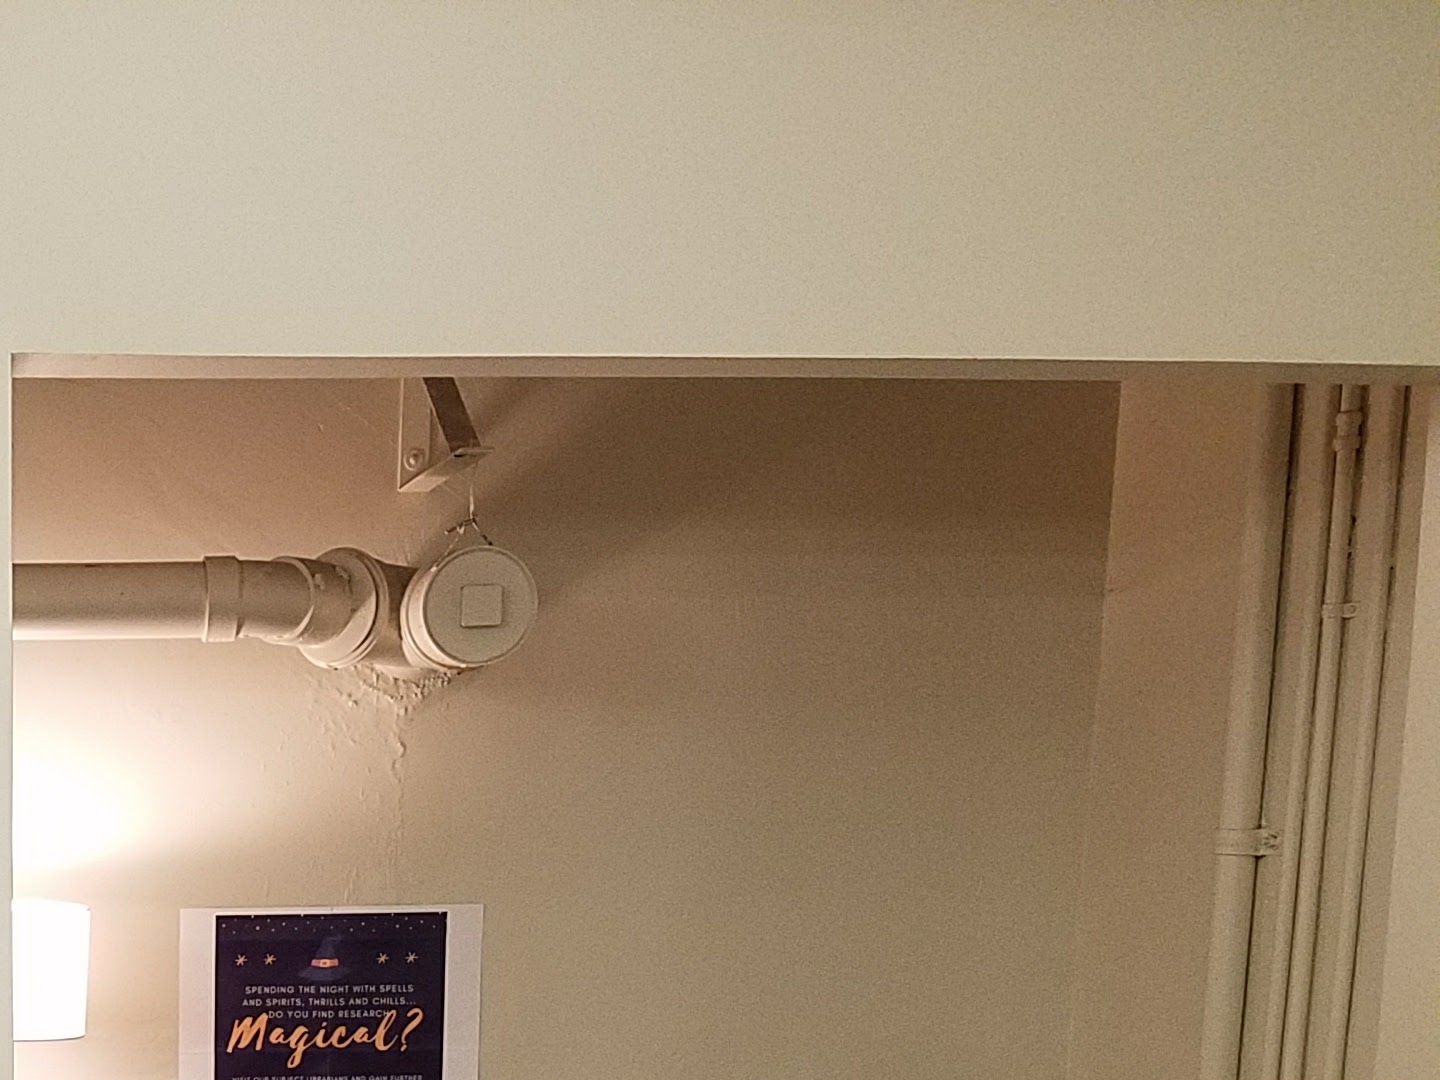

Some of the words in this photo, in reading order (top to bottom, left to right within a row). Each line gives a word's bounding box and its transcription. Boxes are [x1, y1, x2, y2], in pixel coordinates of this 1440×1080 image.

[245, 985, 295, 995] SPENDING
[299, 985, 316, 994] THE
[320, 985, 349, 994] NIGHT
[353, 985, 376, 993] WITH
[379, 984, 414, 993] SPELLS
[242, 998, 262, 1007] AND
[266, 998, 305, 1007] SPIRITS,
[309, 998, 345, 1006] THRILLS
[348, 997, 369, 1006] AND
[372, 997, 417, 1006] CHILLS...
[269, 1010, 283, 1019] DO
[287, 1010, 308, 1019] YOU
[312, 1010, 335, 1018] FIND
[226, 1007, 424, 1069] Magical?
